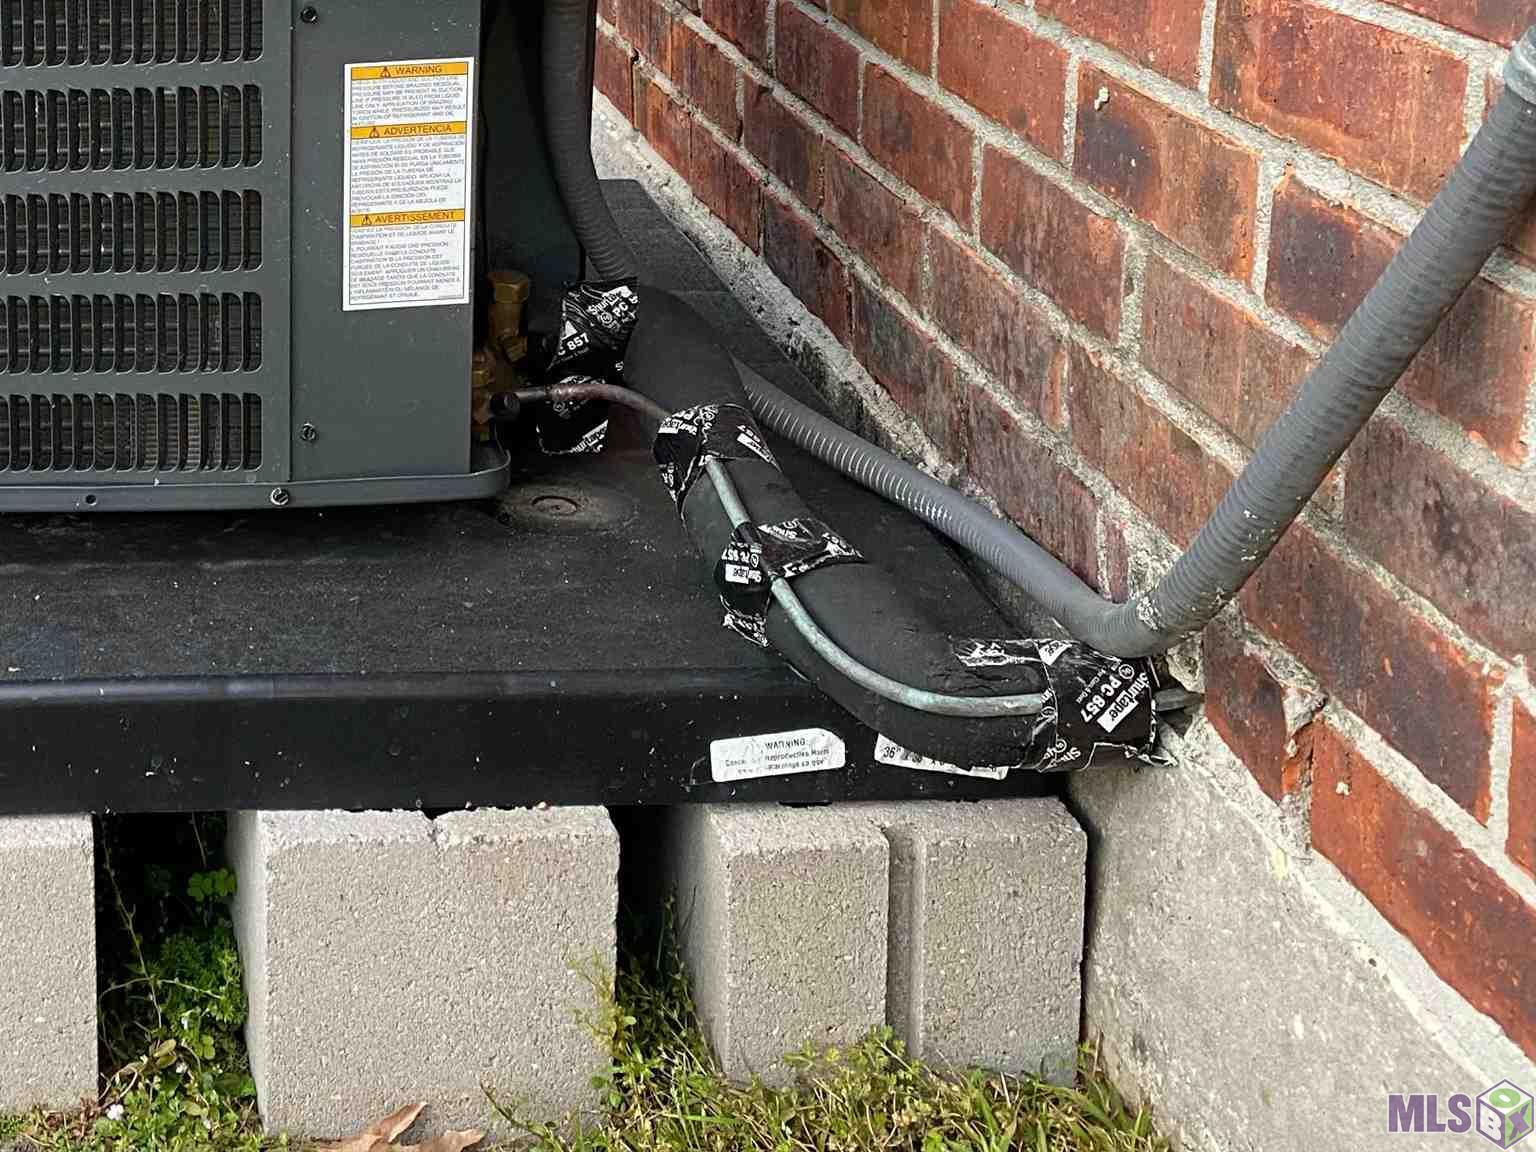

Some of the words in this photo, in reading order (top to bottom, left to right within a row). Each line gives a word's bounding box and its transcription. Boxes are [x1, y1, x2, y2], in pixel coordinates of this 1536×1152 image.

[395, 64, 443, 76] WARNING
[384, 124, 452, 136] ADVERTENCIA
[375, 211, 455, 224] AVERTISSEMENT
[566, 332, 590, 350] 857
[1100, 675, 1122, 697] PC
[1108, 672, 1149, 720] Shurtape
[1080, 694, 1106, 723] 857
